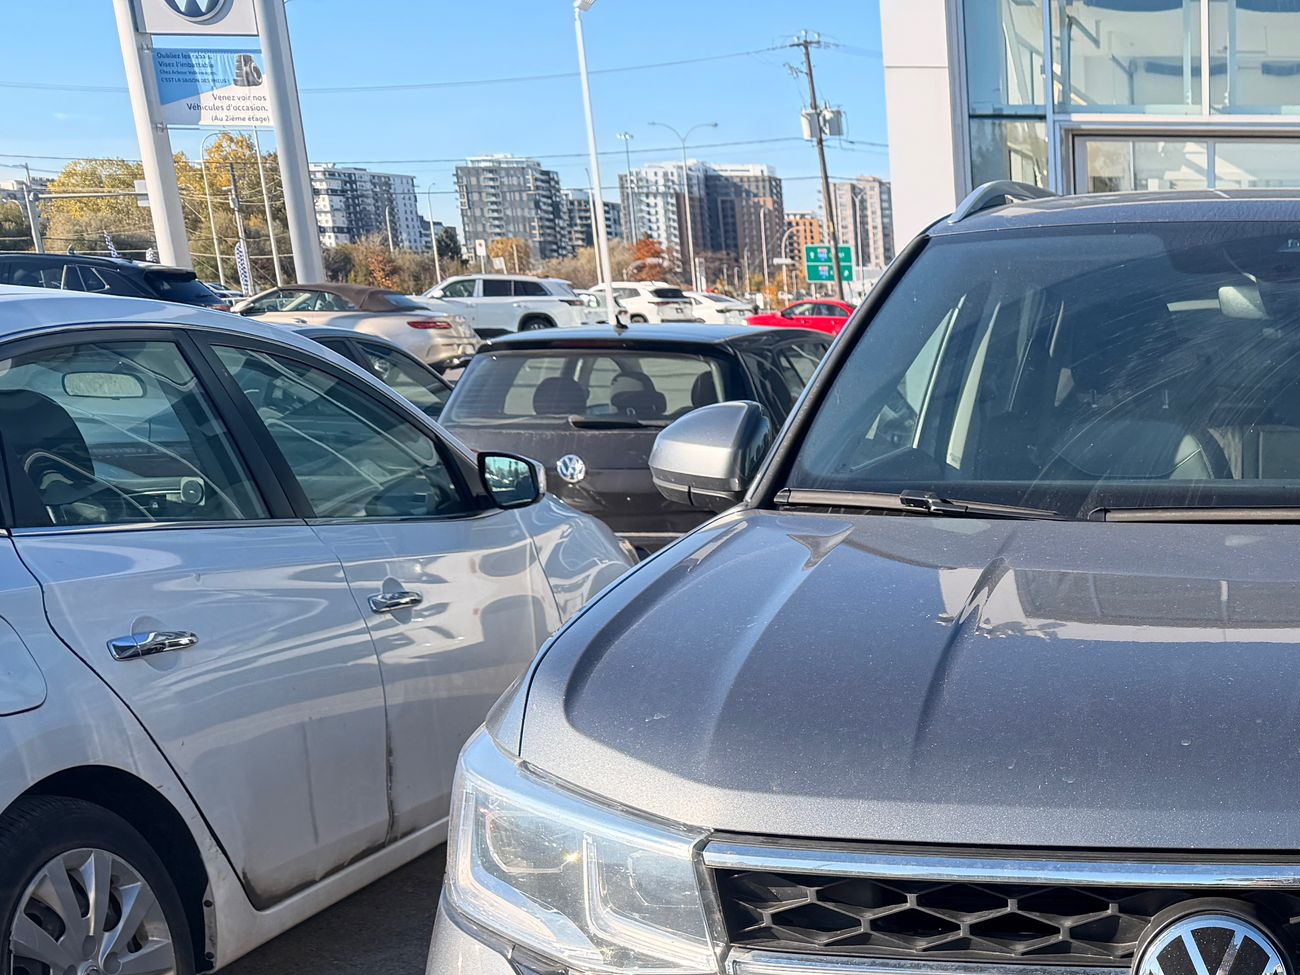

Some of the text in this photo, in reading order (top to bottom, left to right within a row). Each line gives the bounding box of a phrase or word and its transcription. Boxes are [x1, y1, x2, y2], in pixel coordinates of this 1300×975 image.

[212, 93, 235, 101] Venez
[186, 103, 224, 111] Véhicules
[247, 115, 270, 123] étage)
